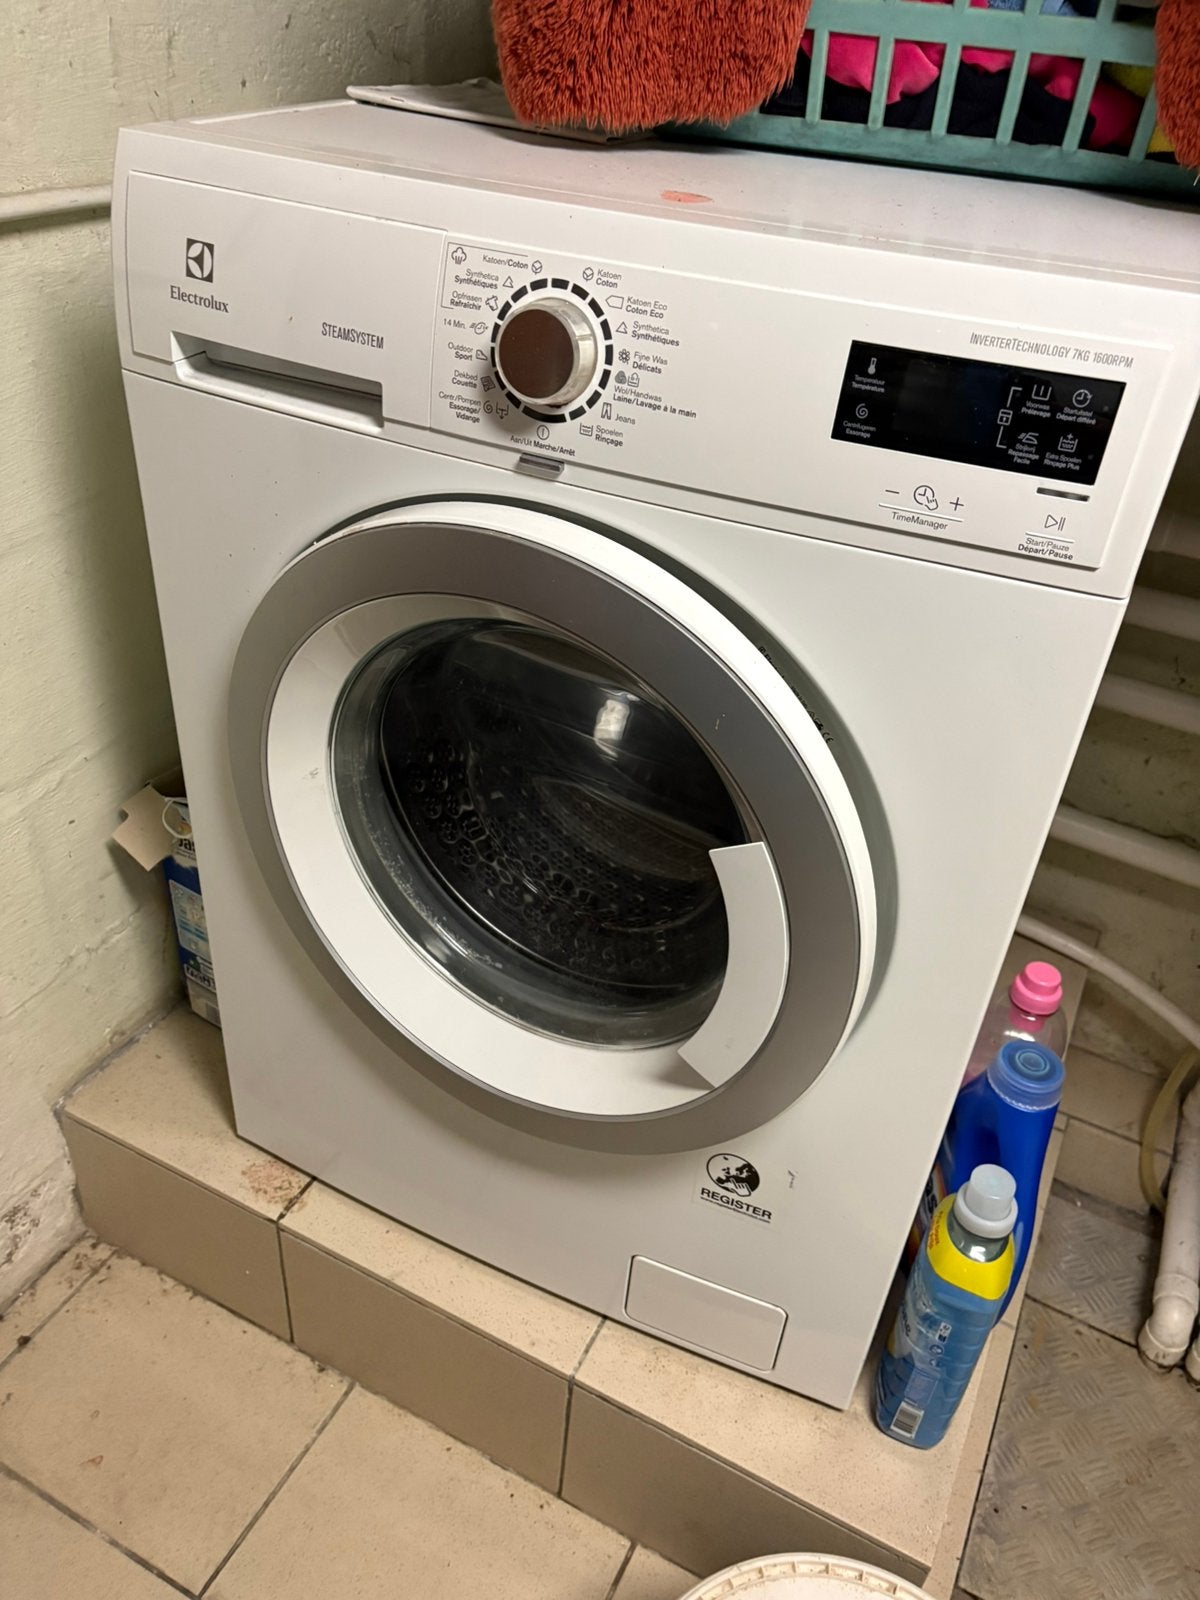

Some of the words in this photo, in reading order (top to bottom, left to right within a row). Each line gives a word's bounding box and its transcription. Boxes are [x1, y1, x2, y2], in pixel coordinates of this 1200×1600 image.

[482, 254, 529, 269] Katoen/Coton
[454, 274, 498, 289] Synthétiques
[465, 268, 499, 281] Synthetica
[597, 269, 622, 280] Katoen
[596, 278, 618, 288] Coton
[170, 285, 229, 313] Electrolux
[627, 296, 652, 308] Katoen
[653, 301, 668, 311] Eco
[625, 305, 648, 316] Coton
[649, 309, 664, 319] Eco
[443, 318, 452, 327] 14
[453, 319, 466, 329] Min.
[633, 321, 669, 335] Synthetica
[321, 322, 384, 349] STEAMSYSTEM
[631, 330, 680, 347] Synthétiques
[448, 342, 473, 353] Outdoor
[454, 351, 473, 361] Sport
[633, 351, 651, 362] Fijne
[652, 355, 668, 365] Was
[1072, 348, 1090, 362] 7KG
[1093, 351, 1135, 369] 1600RPM
[632, 361, 662, 374] Délicats
[454, 370, 478, 381] Dekbed
[452, 377, 477, 389] Couette
[614, 385, 662, 402] Wol/Handwas
[613, 393, 661, 411] Laine/Lavage
[670, 405, 677, 414] la
[678, 409, 697, 418] main
[456, 411, 480, 423] Vidange
[615, 413, 636, 425] Jeans
[595, 424, 624, 438] Spoelen
[510, 435, 532, 447] Aan/Uit
[533, 440, 576, 456] Marche/Arrêt
[595, 433, 624, 447] Rinçage
[1067, 461, 1080, 471] Plus
[891, 511, 949, 531] TimeManager
[1025, 537, 1070, 552] Start/Pauze
[1017, 543, 1074, 561] Départ/Pause
[700, 1187, 772, 1220] REGISTER
